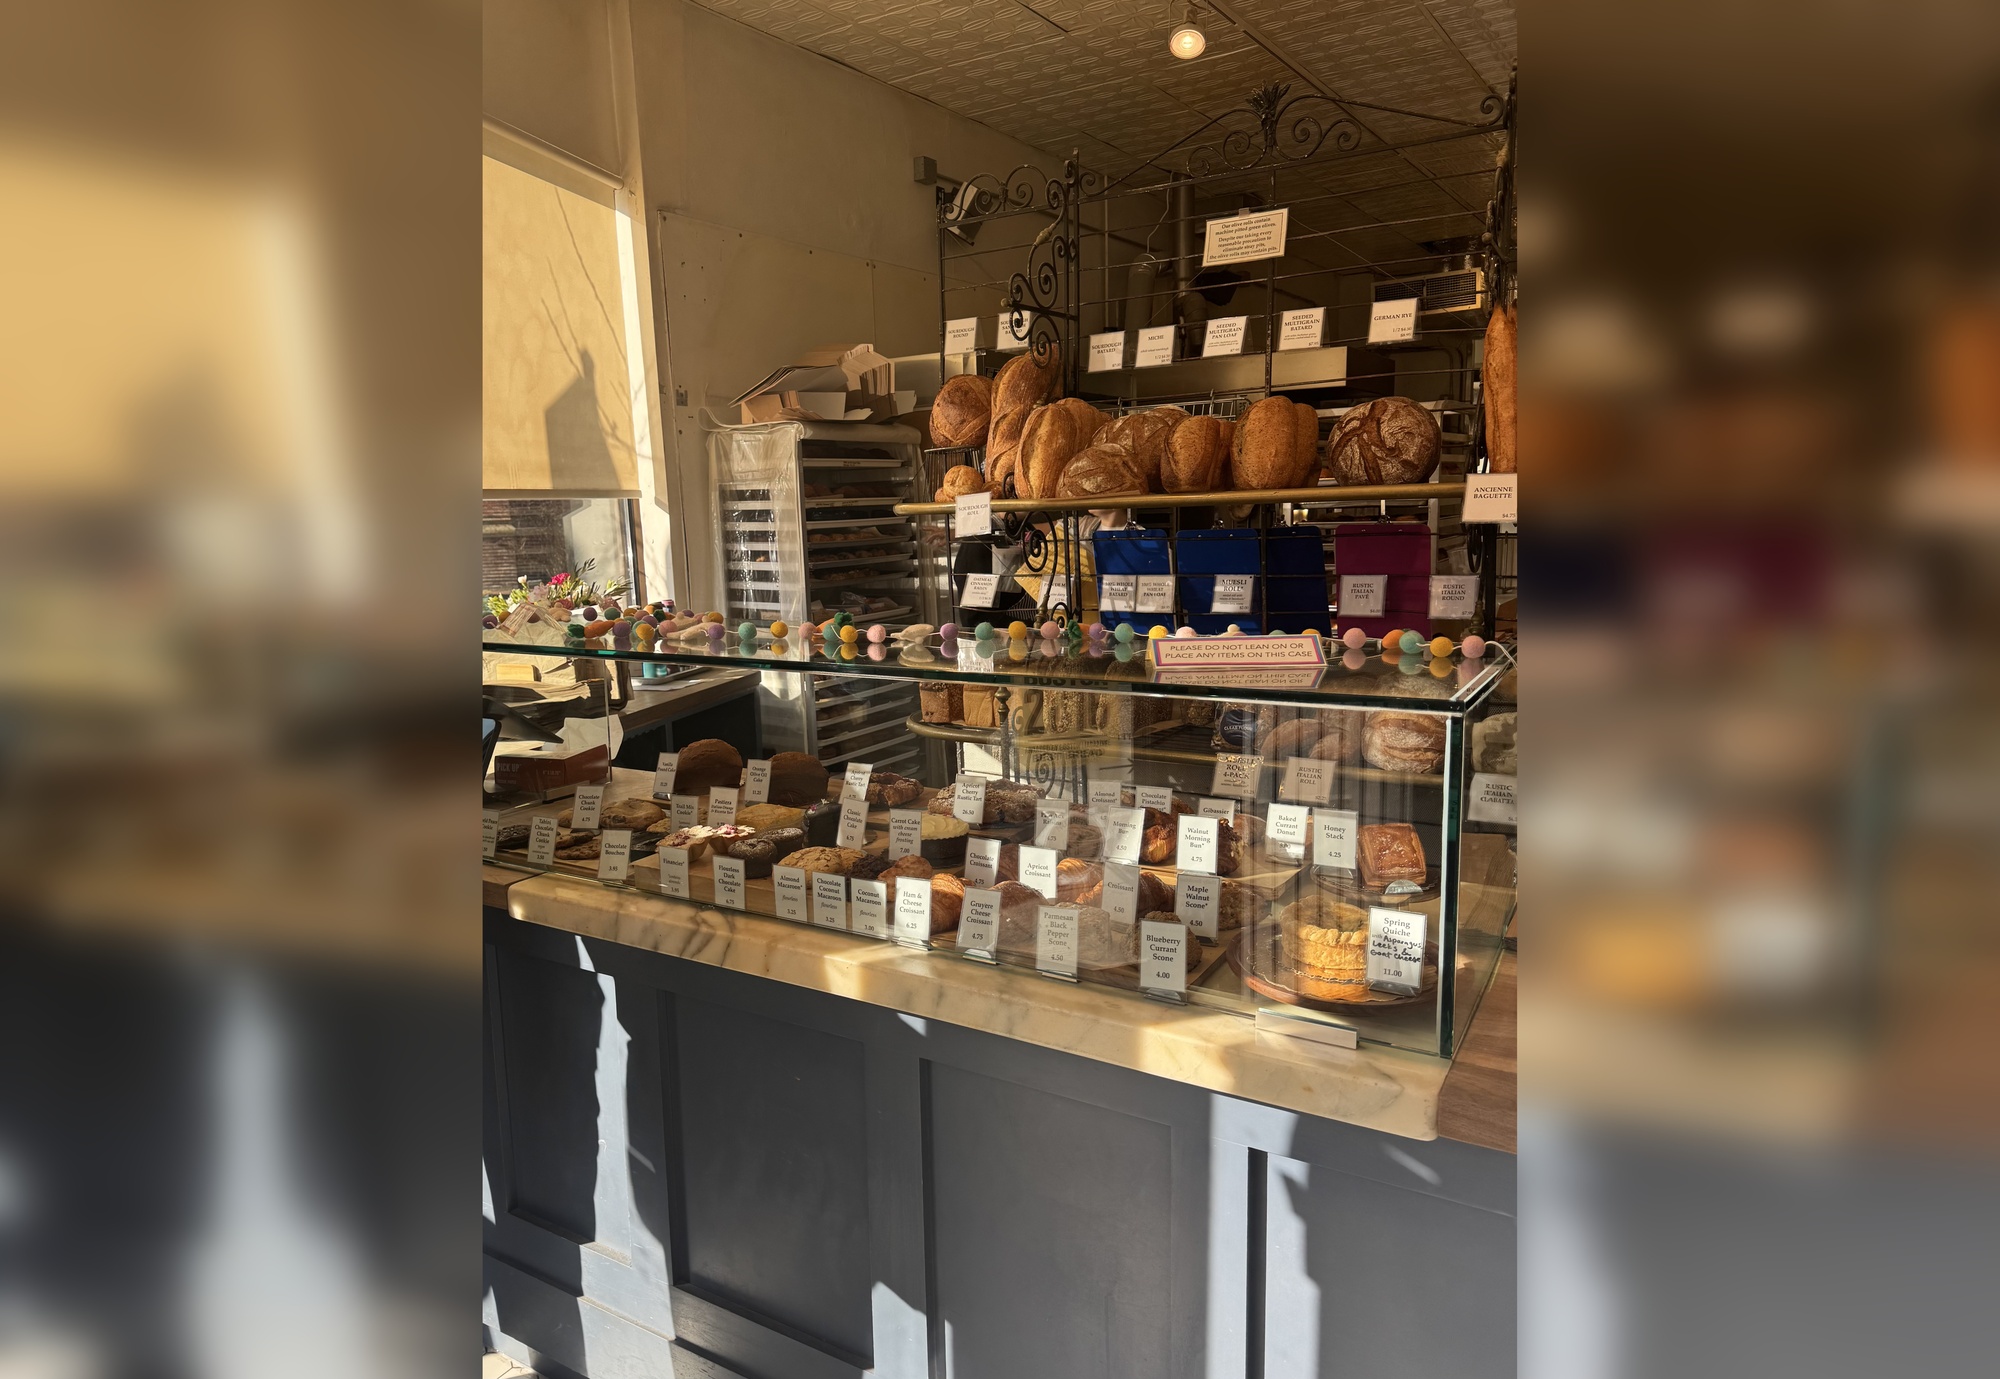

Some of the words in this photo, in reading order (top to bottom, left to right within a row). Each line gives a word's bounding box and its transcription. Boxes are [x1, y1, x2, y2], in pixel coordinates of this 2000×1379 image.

[1234, 226, 1247, 234] pitted
[1242, 237, 1266, 245] precaution
[1485, 783, 1513, 791] RUSTIC
[1203, 807, 1229, 815] Gibassier
[843, 815, 863, 823] Chocolate
[1277, 828, 1296, 836] Donut
[1323, 825, 1346, 833] Honey
[1184, 834, 1211, 844] Morning
[1325, 832, 1344, 840] Stack
[969, 853, 994, 862] Chocolate
[718, 865, 740, 873] Flourless
[969, 860, 993, 869] Croissant
[1027, 862, 1048, 871] Apricot
[1025, 870, 1051, 878] Croissant
[718, 879, 741, 887] Chocolate
[780, 875, 800, 883] Almond
[817, 878, 841, 887] Chocolate
[819, 885, 840, 894] Coconut
[1107, 882, 1134, 892] Croissant
[1187, 885, 1209, 893] Maple
[817, 892, 842, 902] Macaroon
[857, 889, 880, 898] Coconut
[903, 891, 915, 899] Ham
[1186, 893, 1210, 901] Walnut
[856, 896, 881, 906] Macaroon
[902, 899, 922, 907] Cheese
[820, 902, 837, 910] flourless
[899, 906, 925, 915] Croissant
[859, 910, 877, 918] flourless
[970, 908, 991, 917] Cheese
[1044, 912, 1074, 921] Parmesan
[966, 917, 993, 926] Croissant
[1384, 918, 1411, 929] Spring
[1047, 930, 1069, 938] Pepper
[1382, 926, 1411, 937] Quiche
[1146, 934, 1181, 946] Blueberry
[1150, 944, 1177, 953] Currant
[1373, 940, 1397, 952] Leeks
[1402, 948, 1411, 956] &
[1153, 953, 1174, 962] Scone
[1370, 950, 1392, 959] Goat
[1156, 971, 1170, 979] 4.00
[1383, 968, 1402, 977] 11.00
